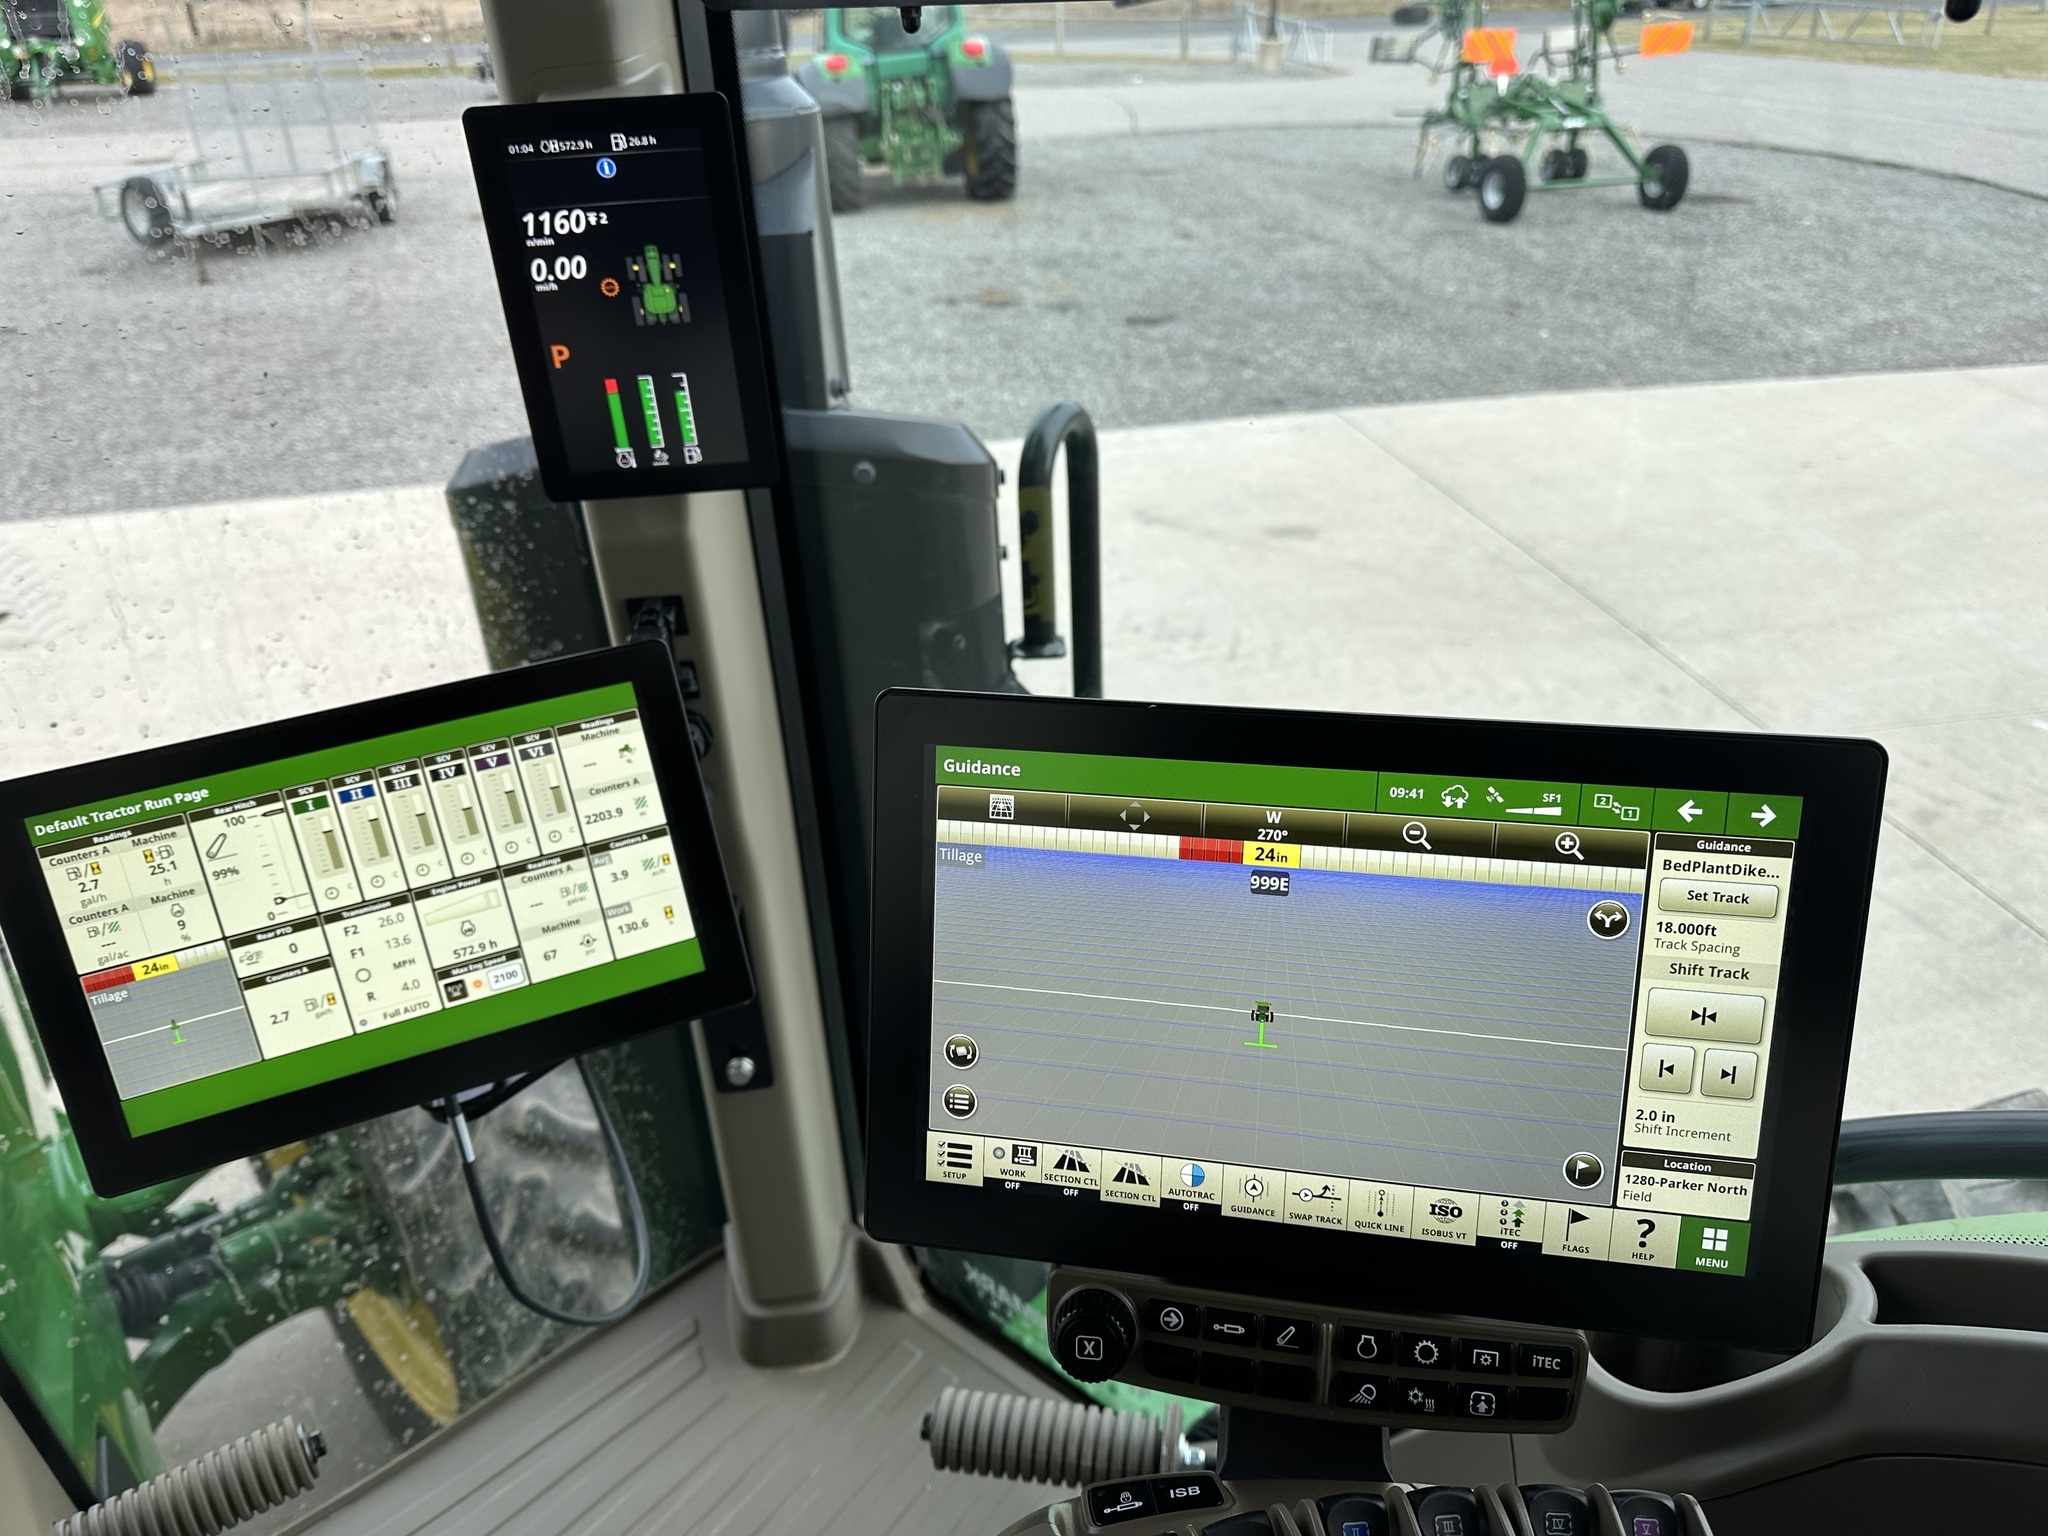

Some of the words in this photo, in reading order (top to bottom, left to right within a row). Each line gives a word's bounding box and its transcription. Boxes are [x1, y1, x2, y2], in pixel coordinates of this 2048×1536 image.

[559, 141, 584, 152] 572.9
[585, 139, 593, 149] h
[628, 135, 648, 147] 26.8
[649, 134, 657, 145] h
[508, 143, 534, 155] 01:04
[521, 208, 587, 238] 1160
[525, 236, 555, 248] n/min
[530, 254, 588, 283] 0.00
[550, 344, 571, 370] P
[581, 717, 614, 730] Readings
[525, 733, 540, 742] SCV
[581, 728, 620, 742] Machine
[481, 743, 497, 753] SCV
[527, 746, 546, 758] VI
[436, 753, 451, 763] SCV
[486, 757, 498, 768] V
[390, 764, 406, 774] SCV
[439, 767, 456, 780] IV
[943, 758, 1021, 778] Guidance
[344, 775, 360, 785] SCV
[393, 778, 413, 790] III
[589, 781, 631, 796] Counters
[633, 778, 641, 786] A
[298, 786, 314, 795] SCV
[350, 790, 364, 801] II
[1389, 786, 1424, 800] 09:41
[1542, 793, 1562, 803] SF1
[34, 814, 90, 837] Default
[89, 803, 142, 825] Tractor
[143, 797, 172, 813] Run
[173, 786, 210, 807] Page
[214, 805, 233, 816] Rear
[233, 800, 257, 811] Hitch
[223, 815, 246, 829] 100
[584, 807, 623, 825] 2203.9
[1266, 810, 1282, 824] W
[92, 829, 132, 845] Readings
[131, 830, 178, 848] Machine
[1257, 828, 1288, 842] 270°
[609, 836, 641, 849] Counters
[1696, 840, 1752, 853] Guidance
[49, 849, 100, 868] Counters
[101, 846, 111, 856] A
[939, 847, 983, 866] Tillage
[148, 861, 178, 876] 25.1
[526, 857, 561, 871] Readings
[1662, 858, 1781, 879] BedPlantDike...
[212, 866, 240, 881] 99%
[521, 867, 564, 884] Counters
[566, 864, 573, 872] A
[610, 870, 629, 883] 3.9
[77, 879, 100, 894] 2.7
[164, 877, 171, 886] h
[430, 884, 457, 897] Engine
[458, 877, 481, 890] Power
[1250, 874, 1289, 892] 999E
[80, 894, 108, 910] gal/h
[150, 887, 196, 905] Machine
[1687, 889, 1709, 902] Set
[1712, 891, 1750, 905] Track
[69, 907, 120, 926] Counters
[121, 903, 130, 913] A
[342, 900, 392, 918] Transmission
[607, 904, 631, 917] Work
[267, 912, 275, 921] 0
[378, 912, 405, 928] 26.0
[177, 919, 187, 931] 9
[343, 924, 360, 937] F2
[541, 918, 581, 935] Machine
[618, 918, 649, 935] 130.6
[1656, 920, 1717, 937] 18.000ft
[180, 933, 191, 943] %
[256, 930, 275, 941] Rear
[276, 925, 293, 936] PTO
[289, 942, 298, 953] 0
[385, 934, 412, 950] 13.6
[453, 941, 486, 959] 572.9
[489, 939, 498, 949] h
[1654, 937, 1688, 950] Track
[1691, 940, 1741, 957] Spacing
[97, 950, 130, 966] gal/ac
[350, 946, 365, 959] F1
[543, 949, 557, 961] 67
[392, 957, 415, 970] MPH
[484, 955, 506, 968] Speed
[266, 969, 302, 983] Counters
[493, 970, 518, 983] 2100
[1669, 962, 1705, 977] Shift
[1708, 965, 1750, 980] Track
[401, 978, 421, 992] 4.0
[90, 989, 128, 1006] Tillage
[366, 991, 376, 1002] R
[382, 1008, 402, 1020] Full
[403, 1001, 430, 1014] AUTO
[270, 1011, 289, 1025] 2.7
[1635, 1109, 1658, 1122] 2.0
[1661, 1110, 1675, 1123] in
[1634, 1122, 1663, 1136] Shift
[1665, 1125, 1732, 1143] Increment
[999, 1168, 1026, 1178] WORK
[1663, 1159, 1712, 1173] Location
[942, 1171, 967, 1180] SETUP
[1043, 1173, 1081, 1186] SECTION
[1083, 1177, 1099, 1187] CTL
[1004, 1181, 1020, 1190] OFF
[1624, 1173, 1704, 1192] 1280-Parker
[1707, 1183, 1748, 1196] North
[1063, 1187, 1079, 1197] OFF
[1104, 1189, 1136, 1201] SECTION
[1138, 1193, 1156, 1203] CTL
[1168, 1187, 1215, 1201] AUTOTRAC
[1622, 1190, 1652, 1203] Field
[1183, 1202, 1199, 1212] OFF
[1230, 1205, 1275, 1217] GUIDANCE
[1429, 1203, 1463, 1218] ISO
[1289, 1212, 1313, 1222] SWAP
[1315, 1215, 1343, 1226] TRACK
[1354, 1220, 1382, 1231] QUICK
[1384, 1222, 1405, 1233] LINE
[1500, 1227, 1521, 1237] iTEC
[1422, 1228, 1453, 1239] ISOBUS
[1455, 1231, 1467, 1240] VT
[1500, 1240, 1518, 1250] OFF
[1562, 1243, 1590, 1254] FLAGS
[1631, 1252, 1655, 1261] HELP
[1695, 1256, 1729, 1269] MENU
[1083, 1340, 1095, 1356] X
[1532, 1353, 1562, 1371] iTEC
[1170, 1485, 1201, 1498] ISB
